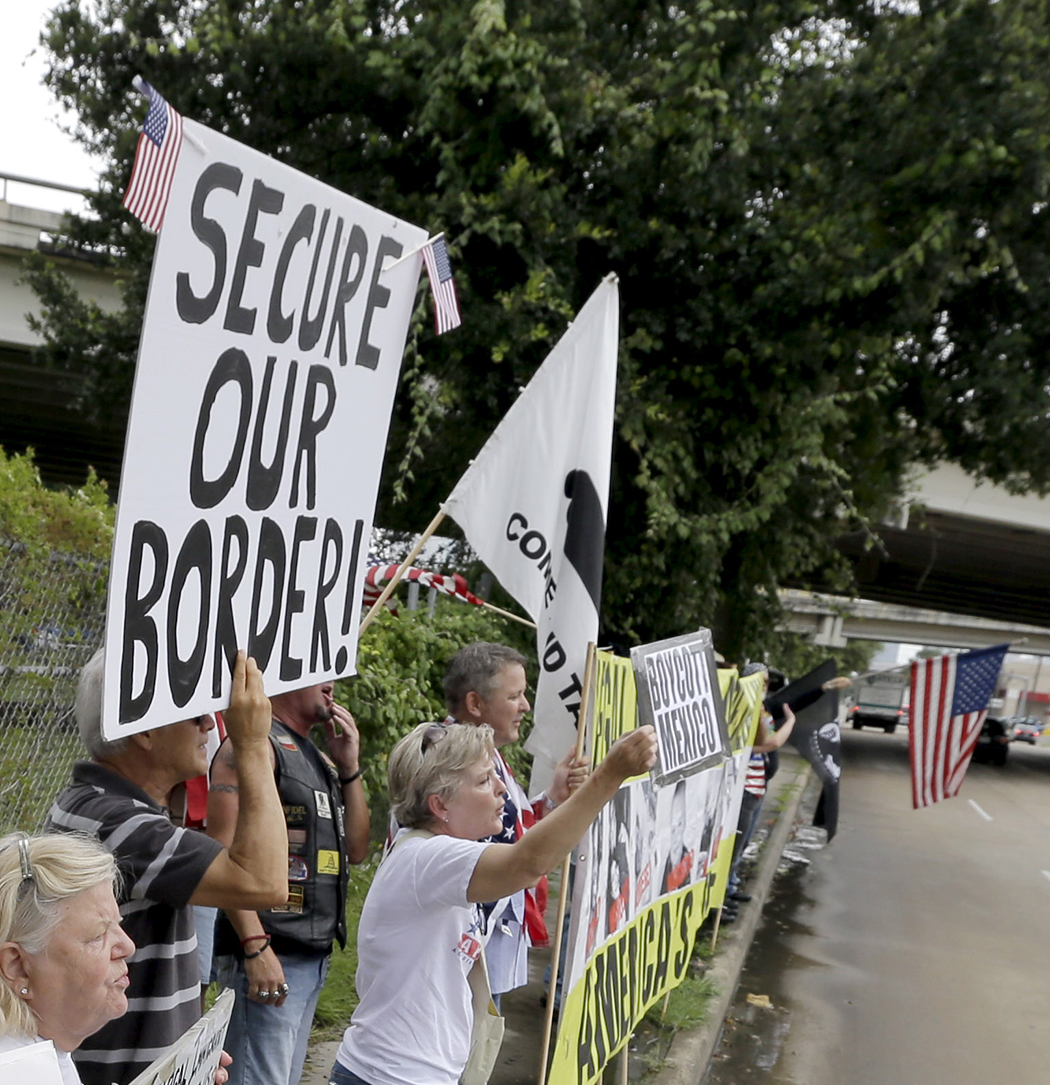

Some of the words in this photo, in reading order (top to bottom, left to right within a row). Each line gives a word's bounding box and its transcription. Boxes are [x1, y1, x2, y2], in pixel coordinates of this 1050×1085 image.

[176, 163, 402, 370] SECURE
[190, 348, 336, 511] OUR
[119, 515, 364, 725] BORDER!
[506, 512, 557, 609] COME
[646, 646, 710, 712] BOYCOTT
[657, 697, 717, 772] MEXICO
